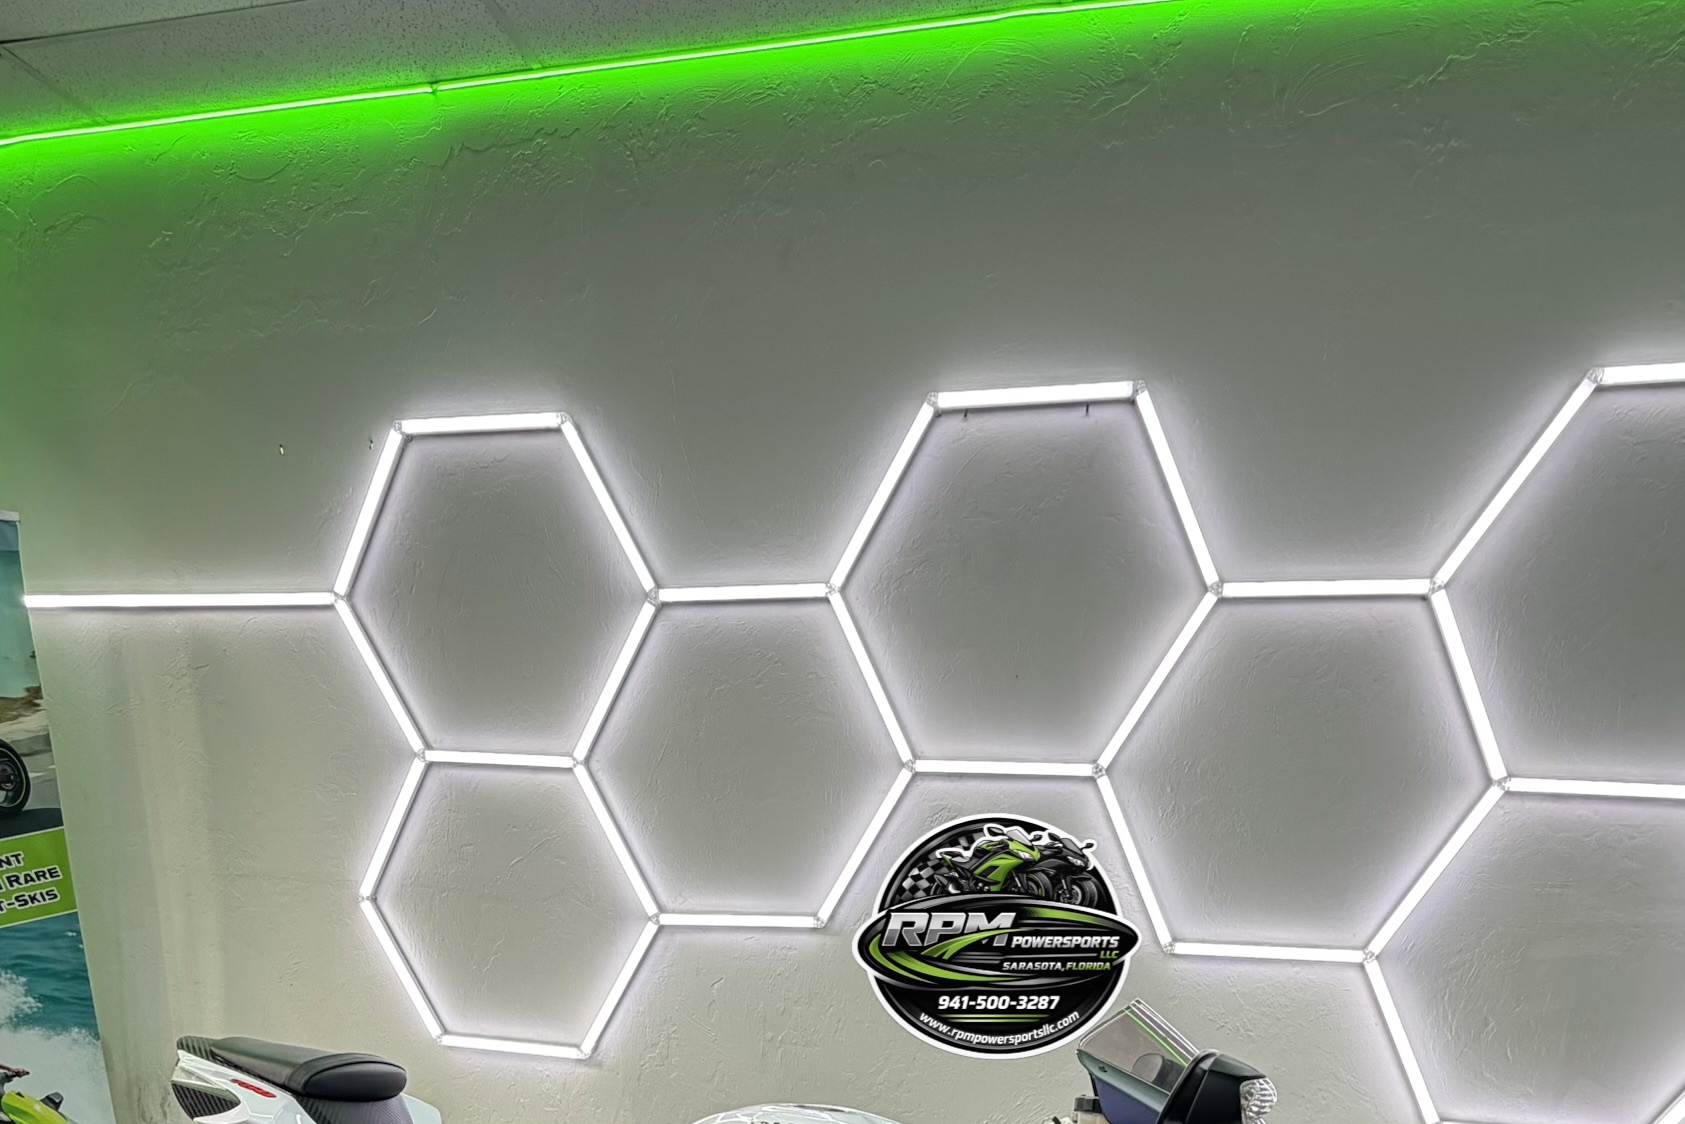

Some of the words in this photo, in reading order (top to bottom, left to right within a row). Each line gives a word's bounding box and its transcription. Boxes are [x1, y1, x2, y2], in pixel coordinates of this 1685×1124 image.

[5, 867, 61, 888] RARE
[881, 912, 1016, 947] RPM
[1011, 936, 1120, 948] POWERSPORTS
[1100, 950, 1119, 959] LLC
[1002, 961, 1065, 972] SARASOTA,
[1065, 961, 1111, 971] FLORIDA
[938, 995, 1060, 1010] 941-500-3287
[919, 1010, 1080, 1046] www.rpmpowersportsllc.com
